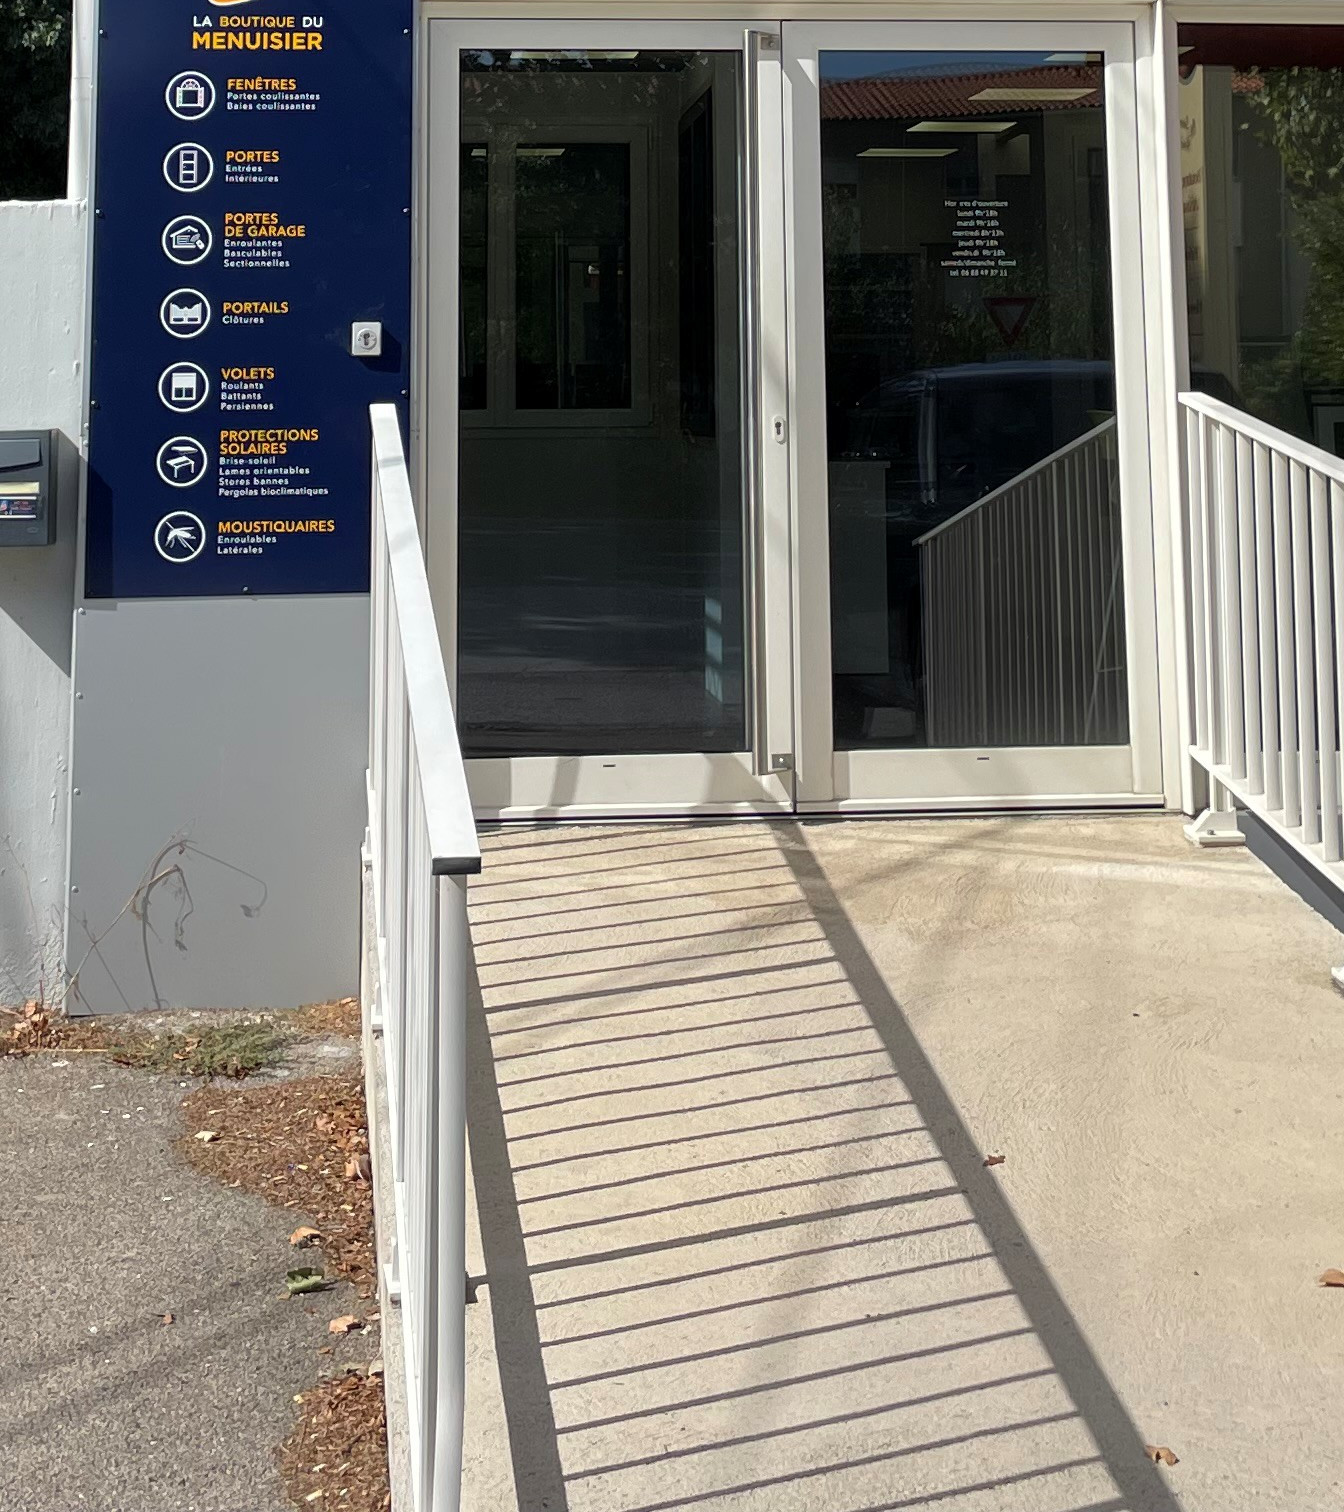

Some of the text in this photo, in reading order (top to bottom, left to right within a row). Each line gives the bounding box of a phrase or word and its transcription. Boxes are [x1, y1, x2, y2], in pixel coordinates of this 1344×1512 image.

[194, 16, 323, 27] LA BOUTIQUE DU
[193, 31, 322, 50] MENUISIER
[228, 77, 296, 90] FENÊTRES
[227, 151, 279, 162] PORTES
[226, 164, 262, 172] Entrées
[225, 213, 278, 224] PORTES
[225, 225, 305, 237] DE GARAGE
[225, 239, 282, 247] Enroulantes
[224, 249, 282, 257] Basculables
[224, 259, 289, 267] Sectionnelles
[223, 302, 288, 314] PORTAILS
[222, 368, 274, 380] VOLETS
[221, 381, 263, 390] Roulants
[221, 392, 261, 400] Battants
[221, 402, 273, 410] Persiennes
[221, 429, 318, 442] PROTECTIONS
[220, 443, 286, 454] SOLAIRES
[254, 466, 309, 475] orientables
[219, 487, 258, 497] Pergolas
[219, 520, 334, 533] MOUSTIQUAIRES
[218, 535, 276, 543] Enroulables
